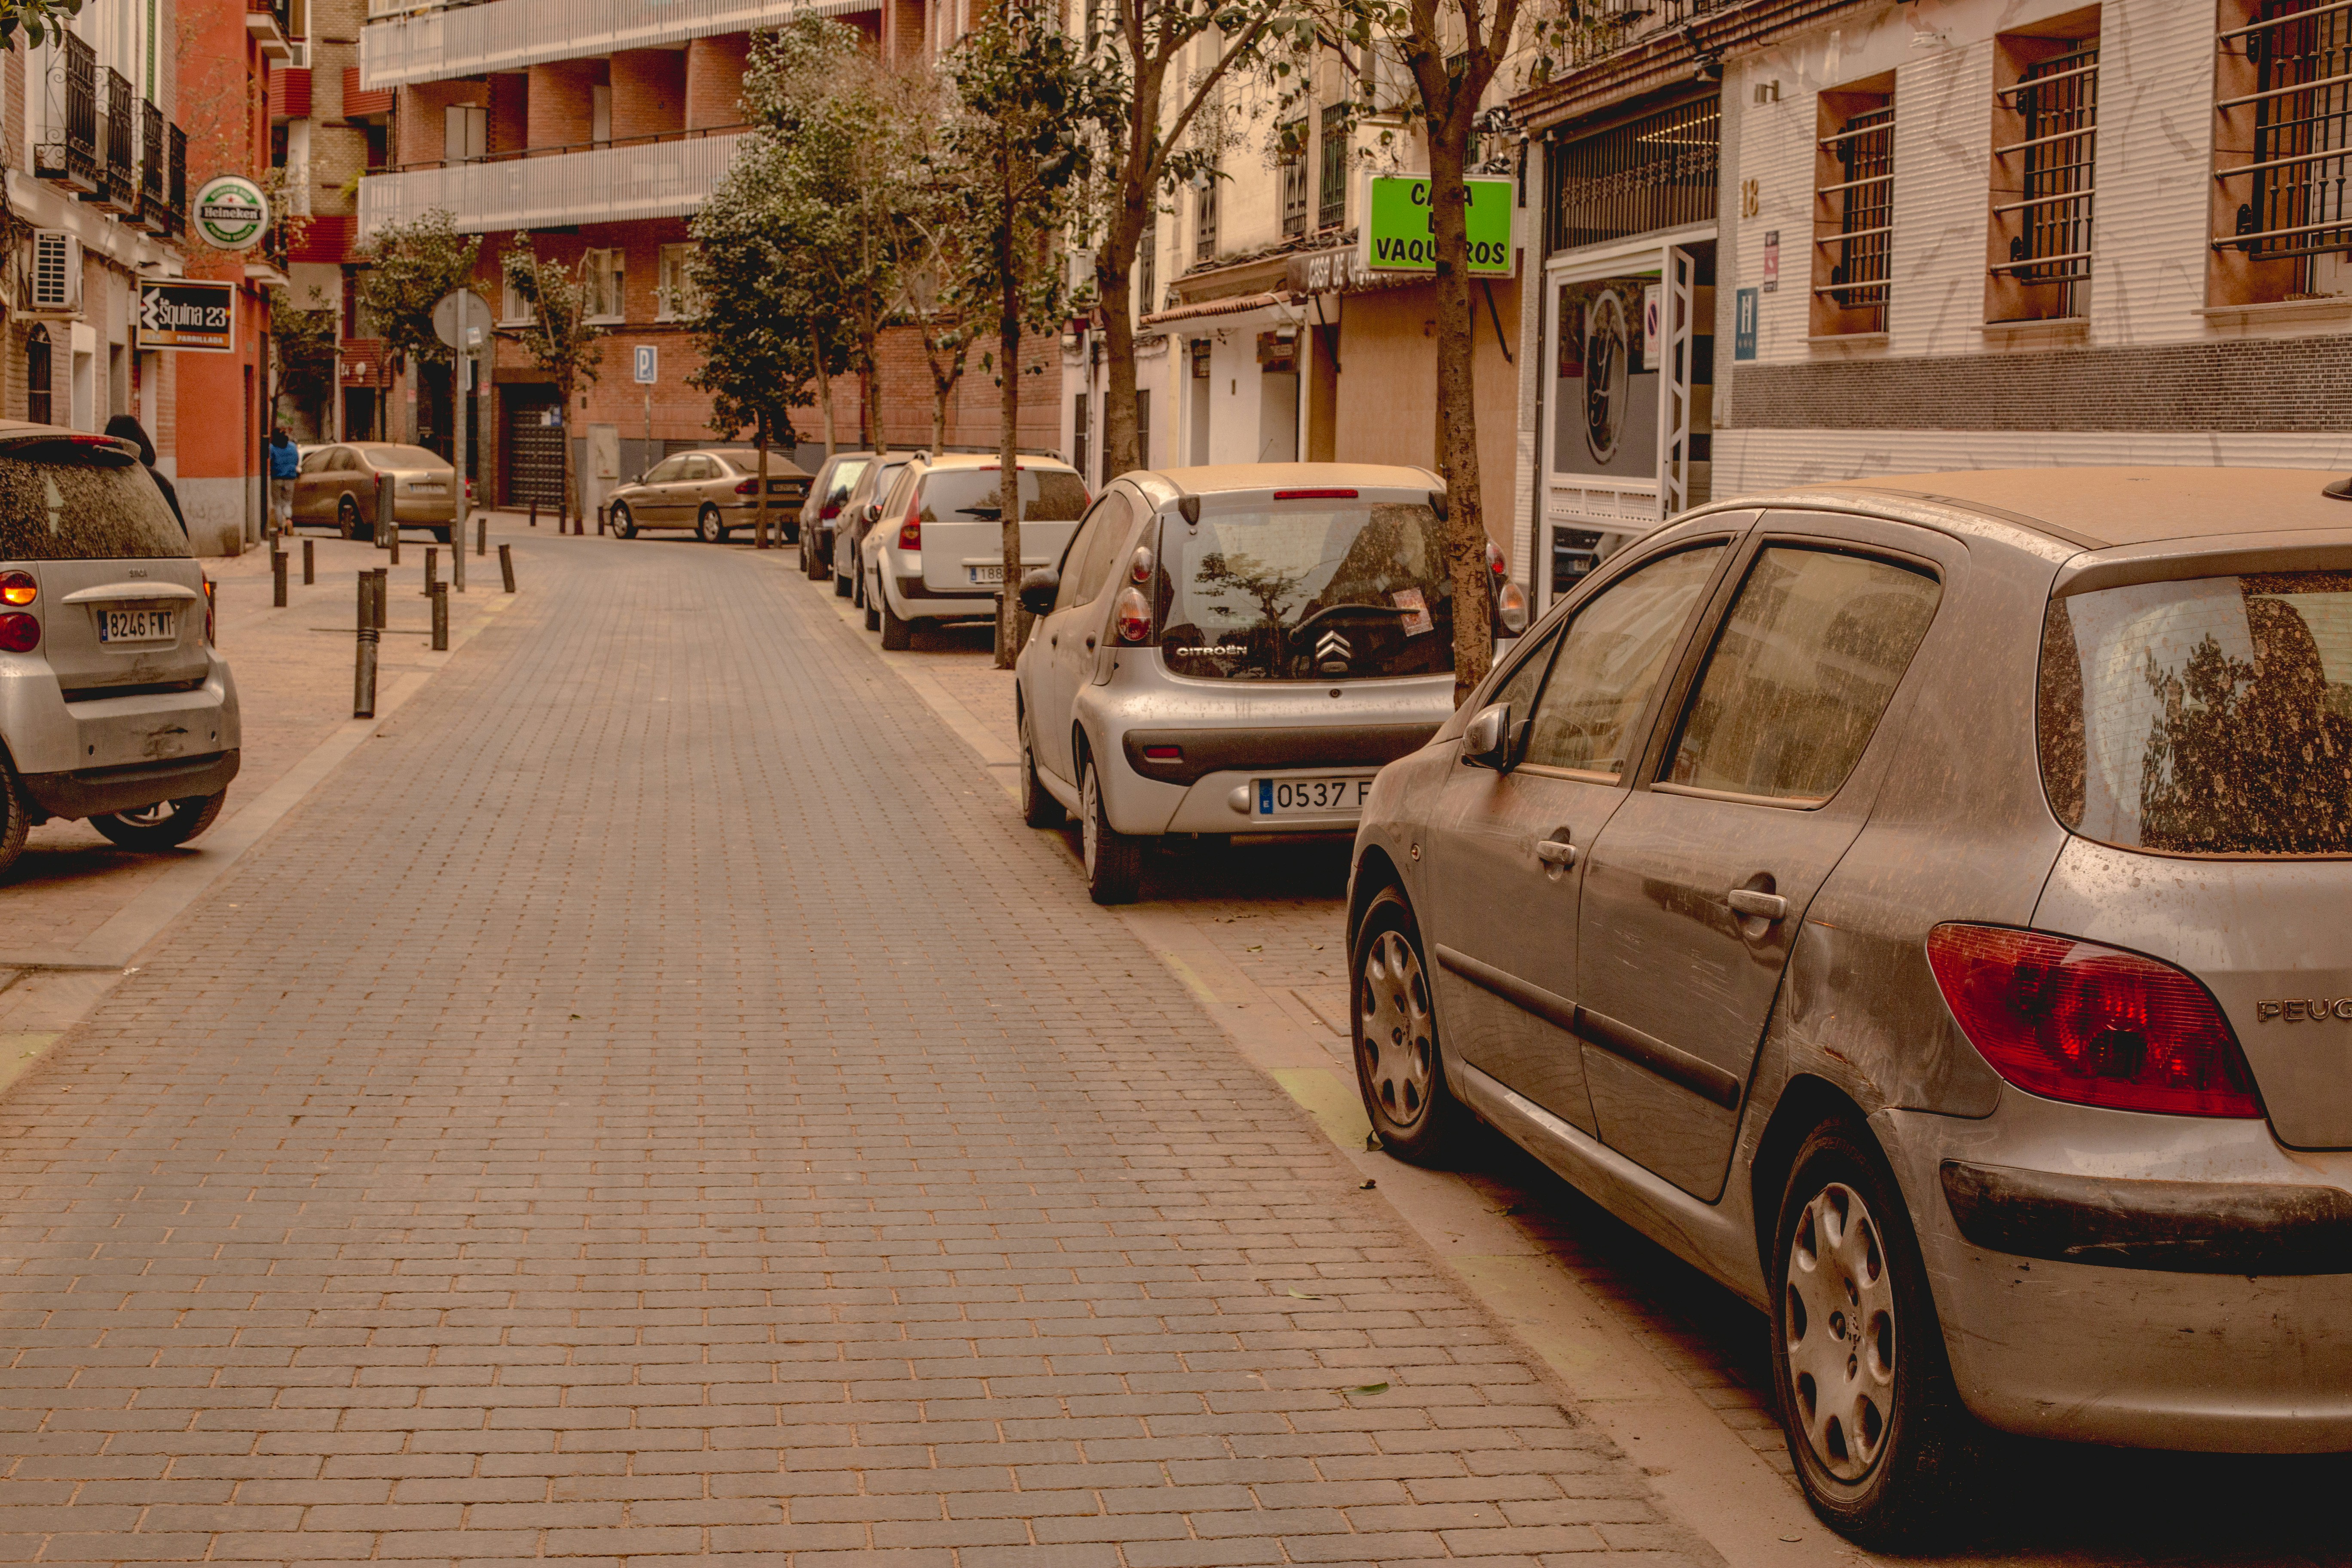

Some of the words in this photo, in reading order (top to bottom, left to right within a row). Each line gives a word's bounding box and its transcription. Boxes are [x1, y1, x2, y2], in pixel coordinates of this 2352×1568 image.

[1411, 183, 1473, 206] CA
[1742, 178, 1759, 219] 18
[204, 207, 258, 219] Heineken
[205, 306, 227, 327] 23
[639, 349, 649, 378] P
[110, 613, 145, 637] 8246
[150, 611, 171, 636] FWT
[1176, 645, 1247, 656] CITROËN
[1278, 782, 1346, 808] 0537
